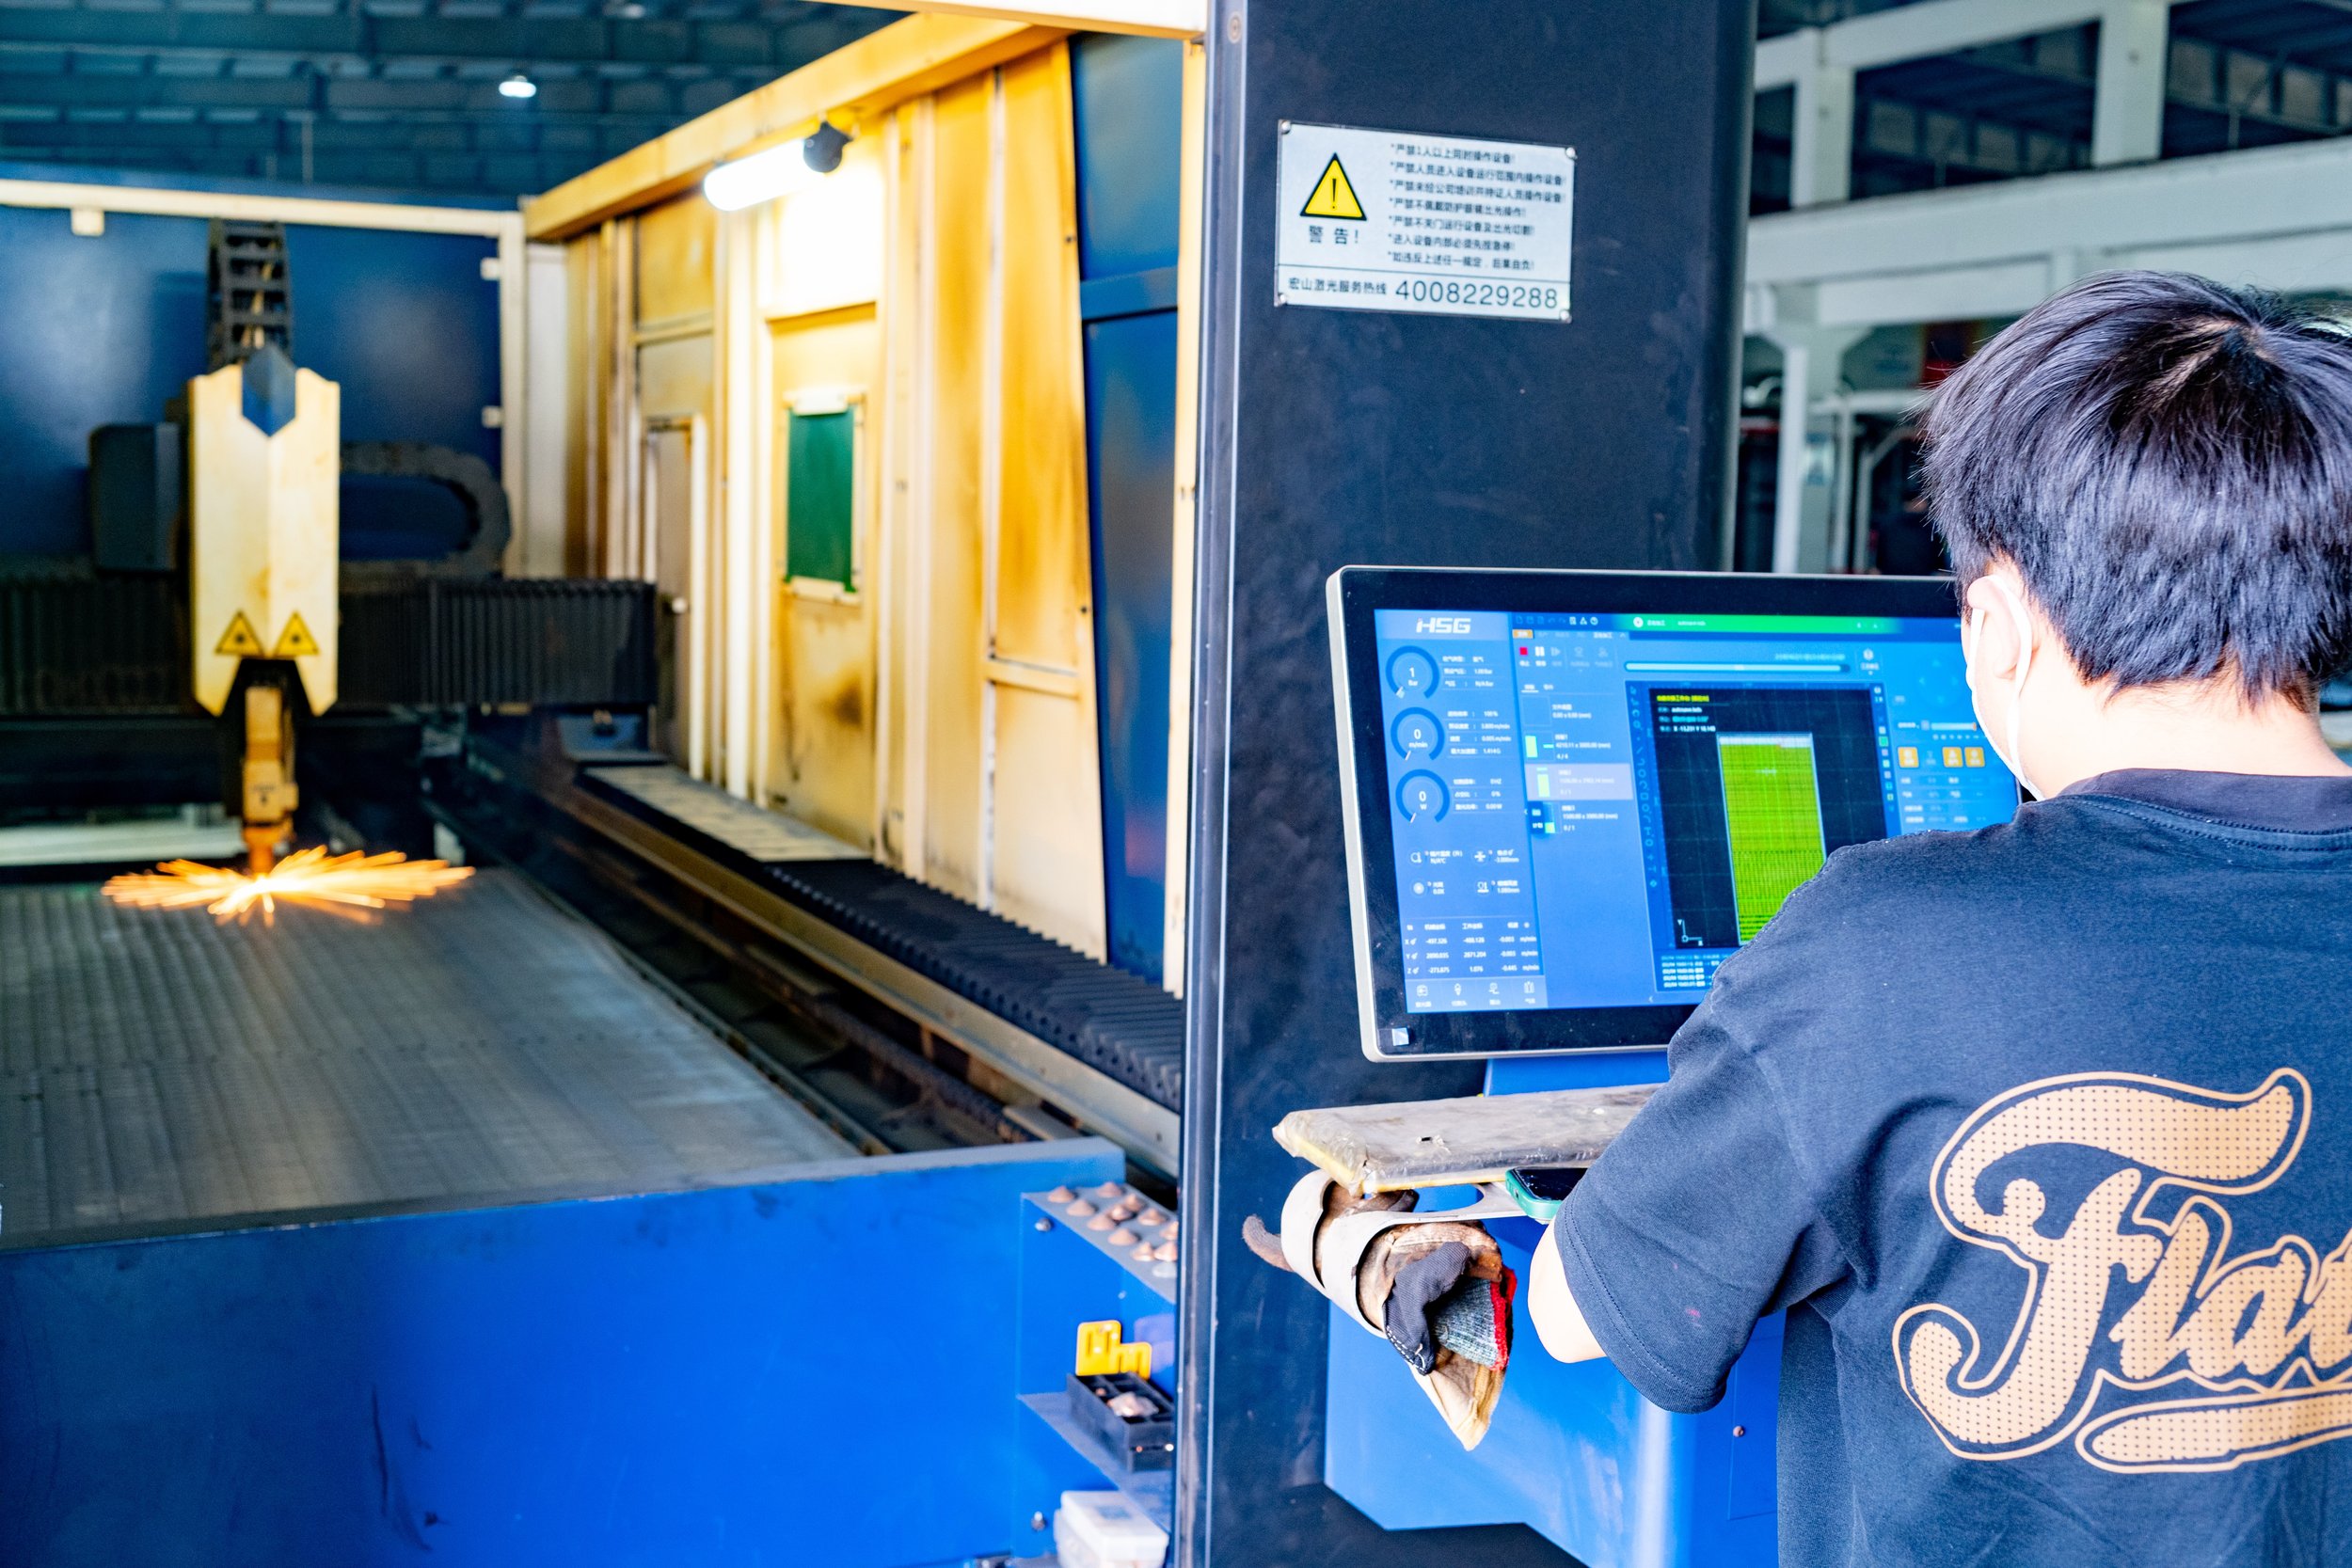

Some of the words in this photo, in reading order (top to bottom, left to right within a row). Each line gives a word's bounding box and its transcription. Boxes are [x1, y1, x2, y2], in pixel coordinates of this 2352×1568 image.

[1289, 277, 1387, 295] 宏山激光服务热线
[1395, 279, 1559, 309] 4008229288
[1416, 617, 1472, 634] HSG
[1409, 667, 1416, 677] 1
[1414, 728, 1422, 740] 0
[1419, 790, 1427, 802] 0
